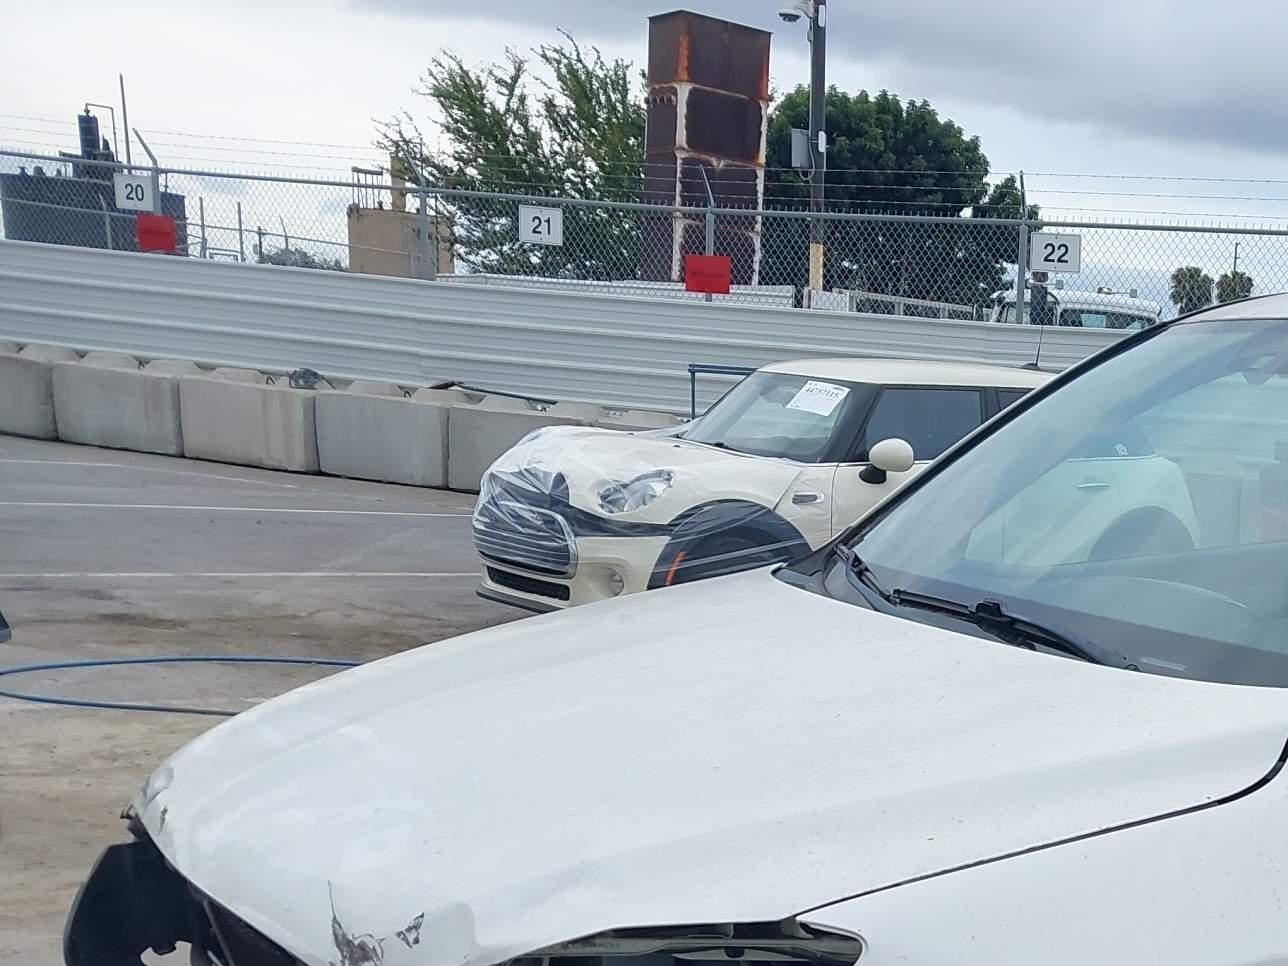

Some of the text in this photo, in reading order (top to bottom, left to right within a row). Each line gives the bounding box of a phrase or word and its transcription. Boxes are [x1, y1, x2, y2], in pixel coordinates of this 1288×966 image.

[125, 183, 145, 202] 20
[531, 215, 551, 236] 21
[1042, 242, 1069, 264] 22
